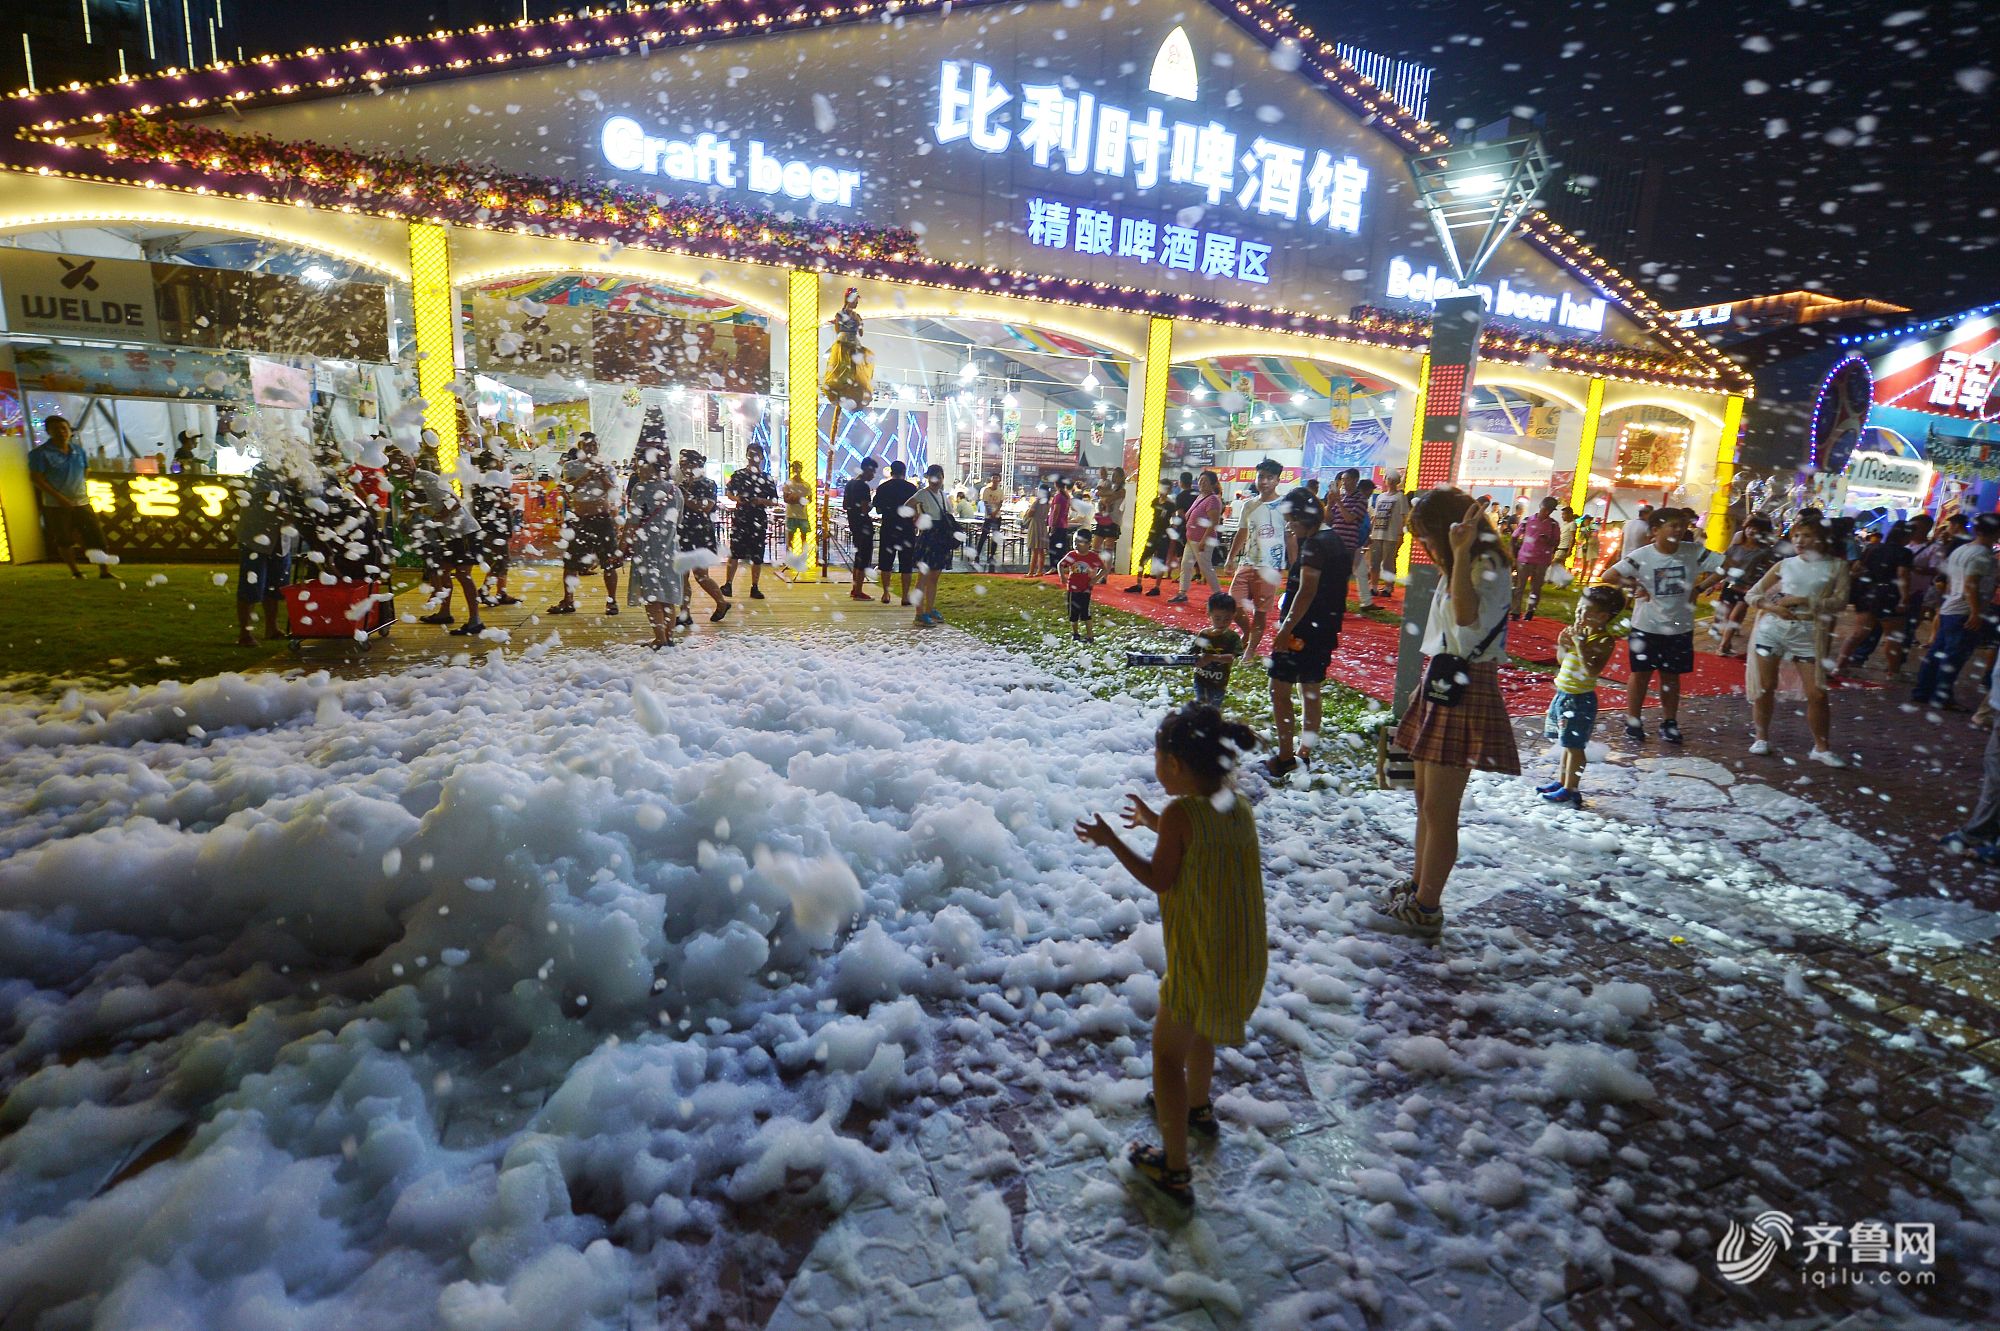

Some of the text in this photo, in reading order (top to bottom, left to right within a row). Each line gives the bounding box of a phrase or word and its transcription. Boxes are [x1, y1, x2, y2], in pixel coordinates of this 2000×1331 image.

[601, 115, 861, 207] Craft beer
[934, 59, 1369, 234] 比利时啤酒馆
[1028, 197, 1272, 284] 精酿啤酒展区
[21, 294, 145, 327] WELDE
[1386, 257, 1609, 333] Belgn beer hall
[1928, 350, 1995, 412] 冠军
